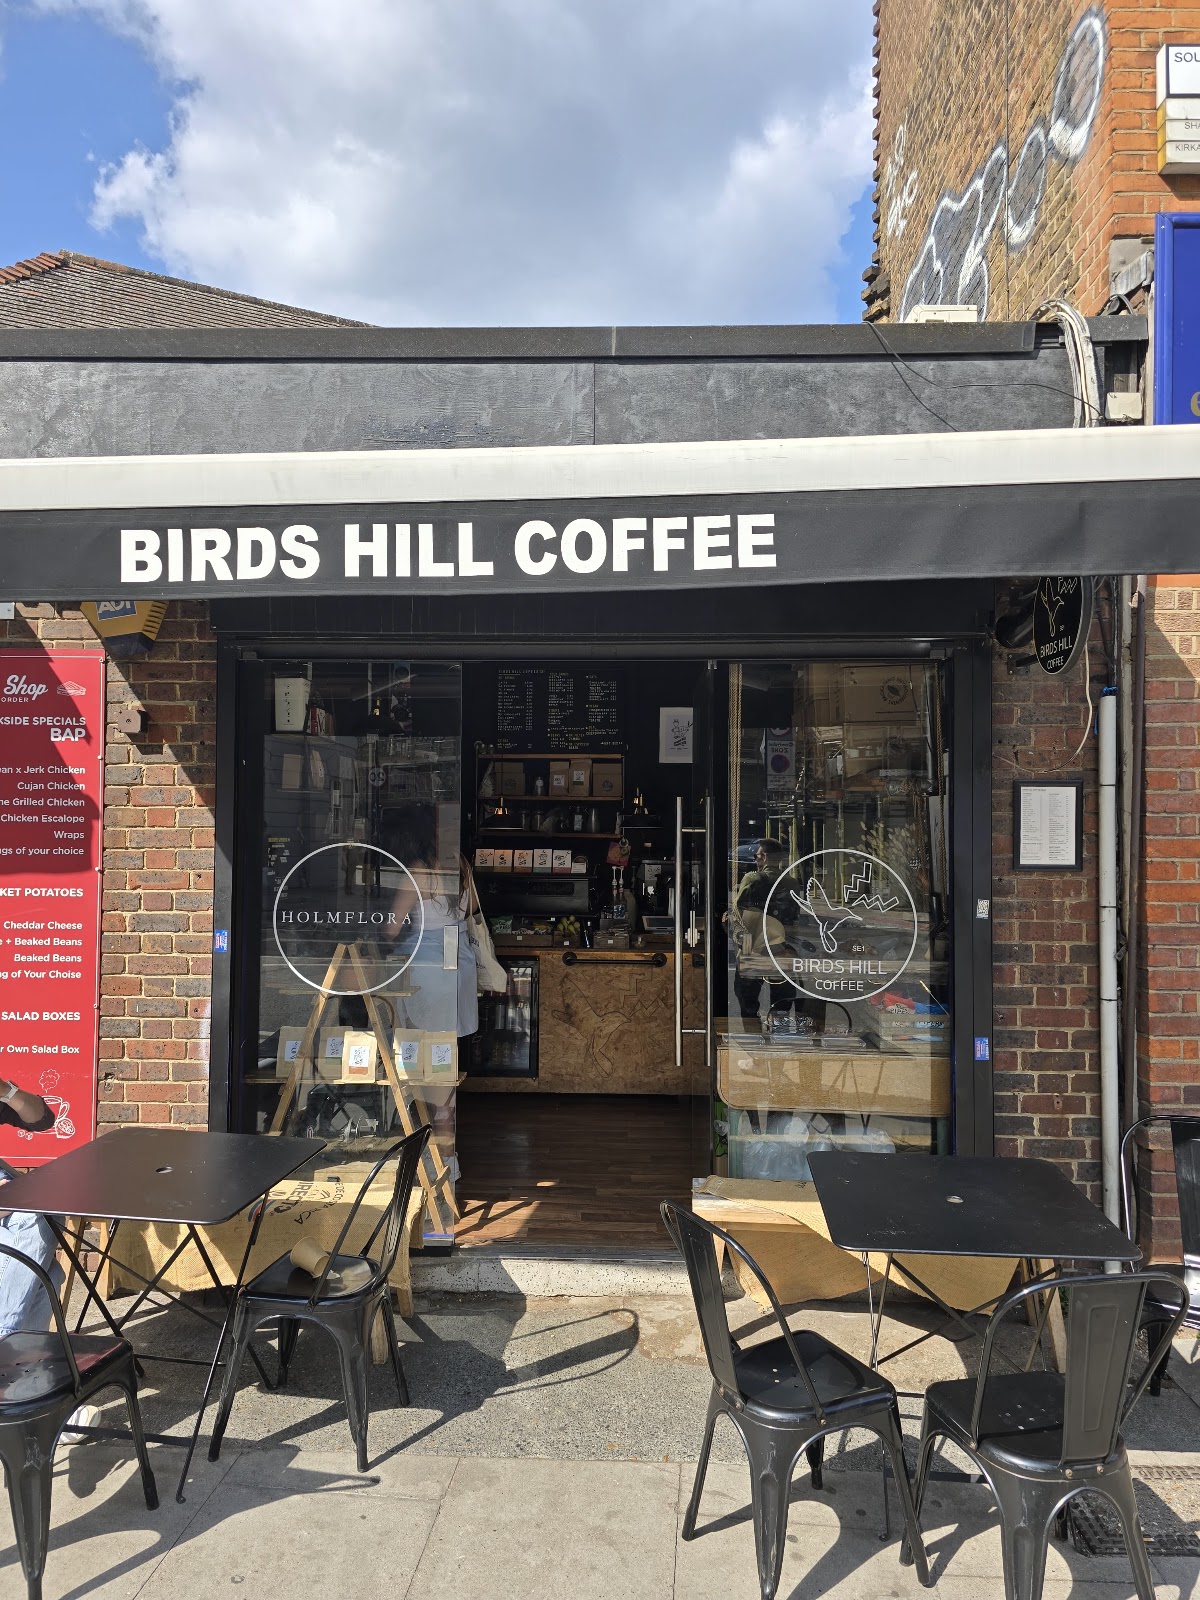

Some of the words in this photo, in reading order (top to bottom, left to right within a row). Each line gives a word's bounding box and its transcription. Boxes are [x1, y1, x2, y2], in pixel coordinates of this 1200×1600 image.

[119, 524, 320, 583] BIRDS
[344, 521, 494, 578] HILL
[514, 514, 777, 576] COFFEE
[1040, 640, 1057, 658] BIRDS
[1058, 635, 1073, 652] HILL
[1046, 655, 1064, 670] COFFEE
[3, 674, 49, 701] Shop
[32, 716, 86, 726] SPECIALS
[50, 727, 86, 742] BAP
[23, 765, 45, 774] Jerk
[47, 765, 86, 774] Chicken
[17, 781, 44, 791] Cujan
[47, 781, 86, 791] Chicken
[12, 797, 44, 806] Grilled
[46, 797, 85, 806] Chicken
[1, 813, 39, 822] Chicken
[41, 814, 85, 824] Escalope
[53, 830, 84, 840] Wraps
[15, 846, 26, 855] of
[28, 848, 50, 856] your
[52, 846, 84, 855] choice
[24, 887, 84, 897] POTATOES
[281, 910, 411, 925] HOLMFLORA
[3, 921, 45, 929] Cheddar
[47, 921, 83, 930] Cheese
[14, 937, 50, 946] Beaked
[53, 937, 83, 946] Beans
[14, 953, 50, 962] Beaked
[52, 953, 82, 962] Beans
[792, 958, 845, 974] BIRDS
[849, 959, 888, 975] HILL
[11, 969, 22, 978] of
[23, 969, 46, 979] Your
[48, 969, 82, 979] Choise
[815, 979, 864, 991] COFFEE
[1, 1011, 39, 1021] SALAD
[42, 1011, 81, 1021] BOXES
[7, 1045, 29, 1053] Own
[31, 1044, 59, 1053] Salad
[61, 1045, 80, 1054] Box
